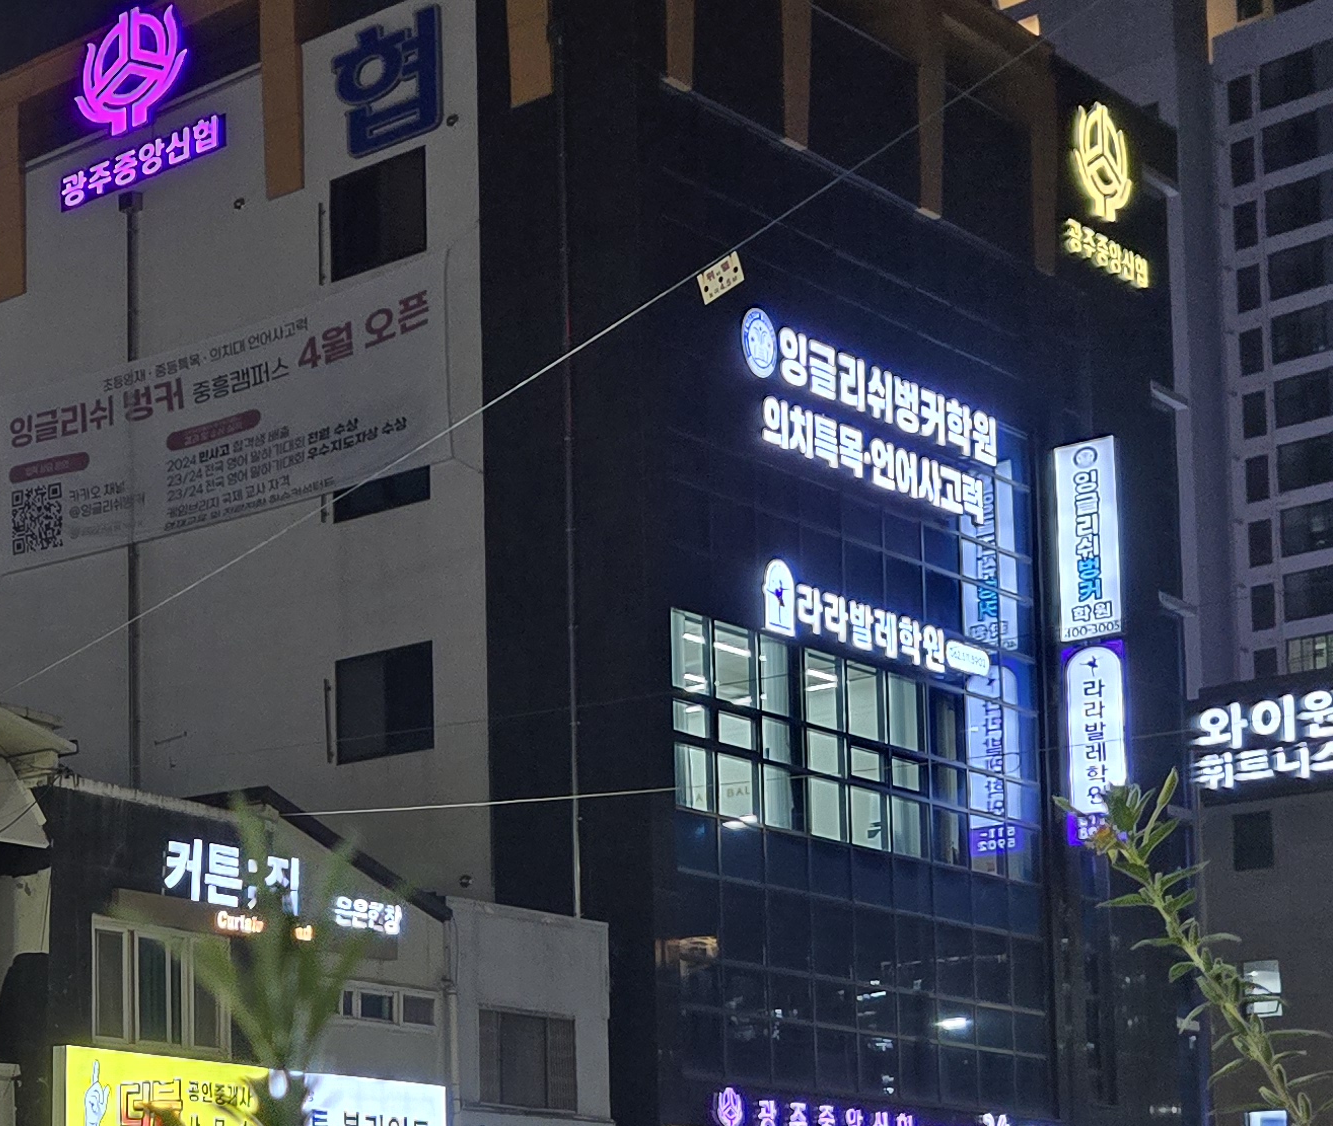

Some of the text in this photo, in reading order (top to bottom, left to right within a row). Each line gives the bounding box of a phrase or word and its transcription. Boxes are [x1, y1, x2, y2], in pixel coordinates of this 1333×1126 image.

[331, 3, 444, 159] 협
[61, 115, 220, 207] 광주중앙신협
[1062, 218, 1149, 288] 광주중앙신협
[10, 290, 430, 448] 잉글리쉬 벙커 중흥캠퍼스 4월 오픈
[248, 317, 309, 350] 언어사고력
[777, 326, 997, 467] 잉글리쉬벙커학원
[166, 468, 203, 487] 23/24
[333, 417, 359, 436] 수상
[166, 483, 203, 502] 23/24
[381, 416, 407, 436] 수상
[166, 456, 197, 473] 2024
[1073, 469, 1103, 602] 잉글리쉬벙커
[795, 583, 946, 673] 라라발레학원
[1072, 601, 1114, 622] 학원
